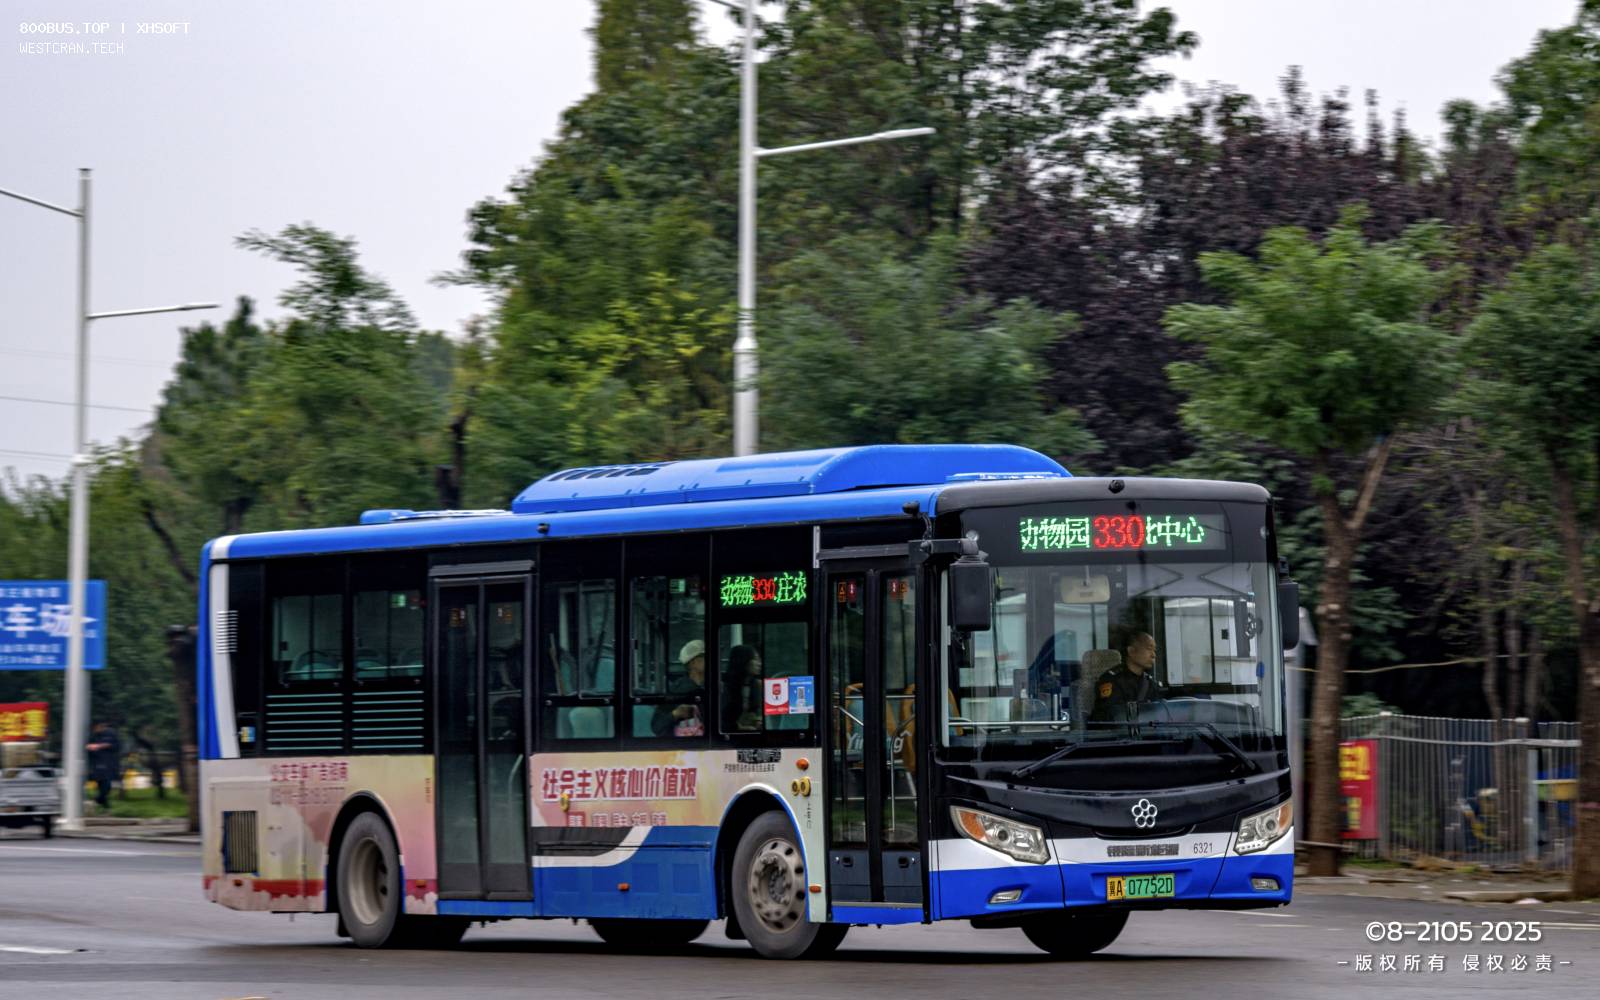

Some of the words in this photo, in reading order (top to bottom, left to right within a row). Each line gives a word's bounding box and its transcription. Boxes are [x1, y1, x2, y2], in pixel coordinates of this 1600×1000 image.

[1092, 515, 1145, 549] 330
[752, 578, 776, 601] 330
[0, 603, 75, 638] 车场
[542, 767, 698, 800] 社会主义核心价值观
[1193, 842, 1214, 854] 6321
[1128, 877, 1173, 896] 07752D
